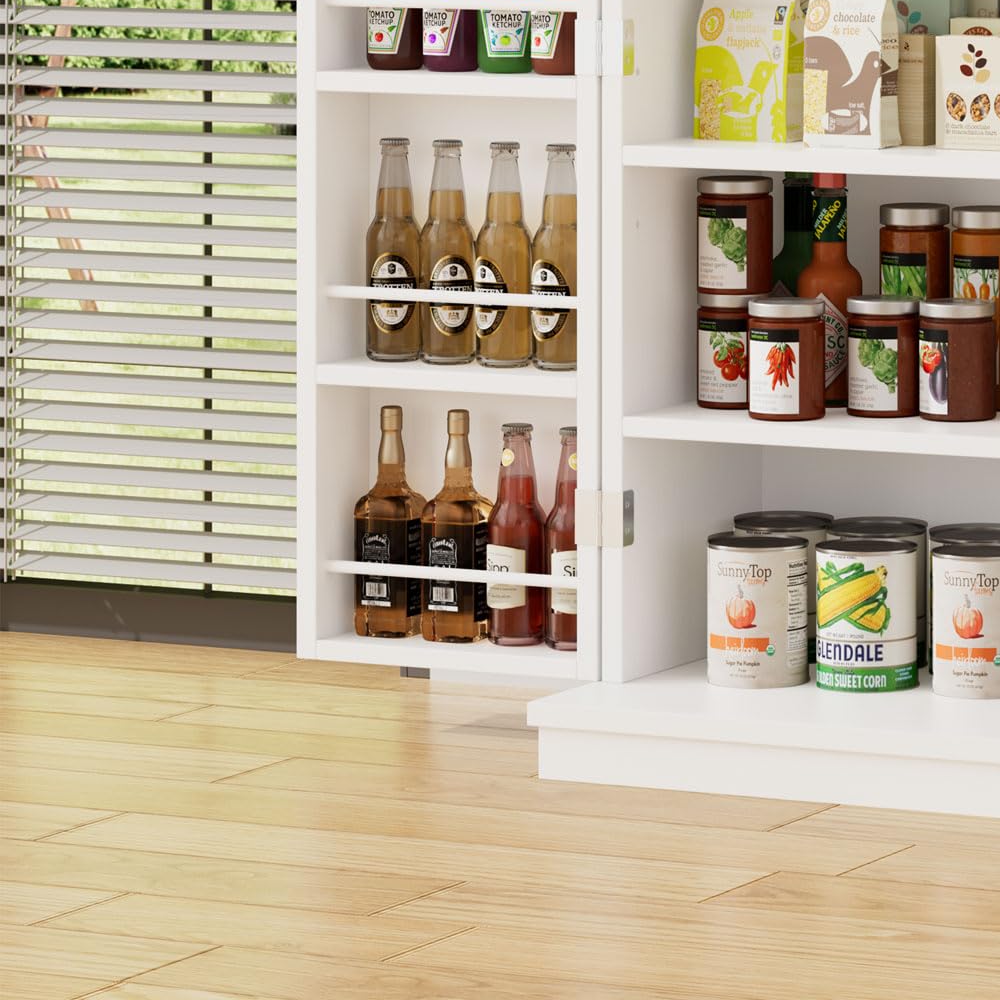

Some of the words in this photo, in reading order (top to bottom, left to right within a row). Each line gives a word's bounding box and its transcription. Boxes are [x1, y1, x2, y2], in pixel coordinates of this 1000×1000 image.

[491, 13, 522, 21] TOMATO
[833, 12, 876, 23] chocolate
[842, 26, 860, 35] rice
[835, 673, 862, 688] SWEET
[863, 674, 887, 688] CORN
